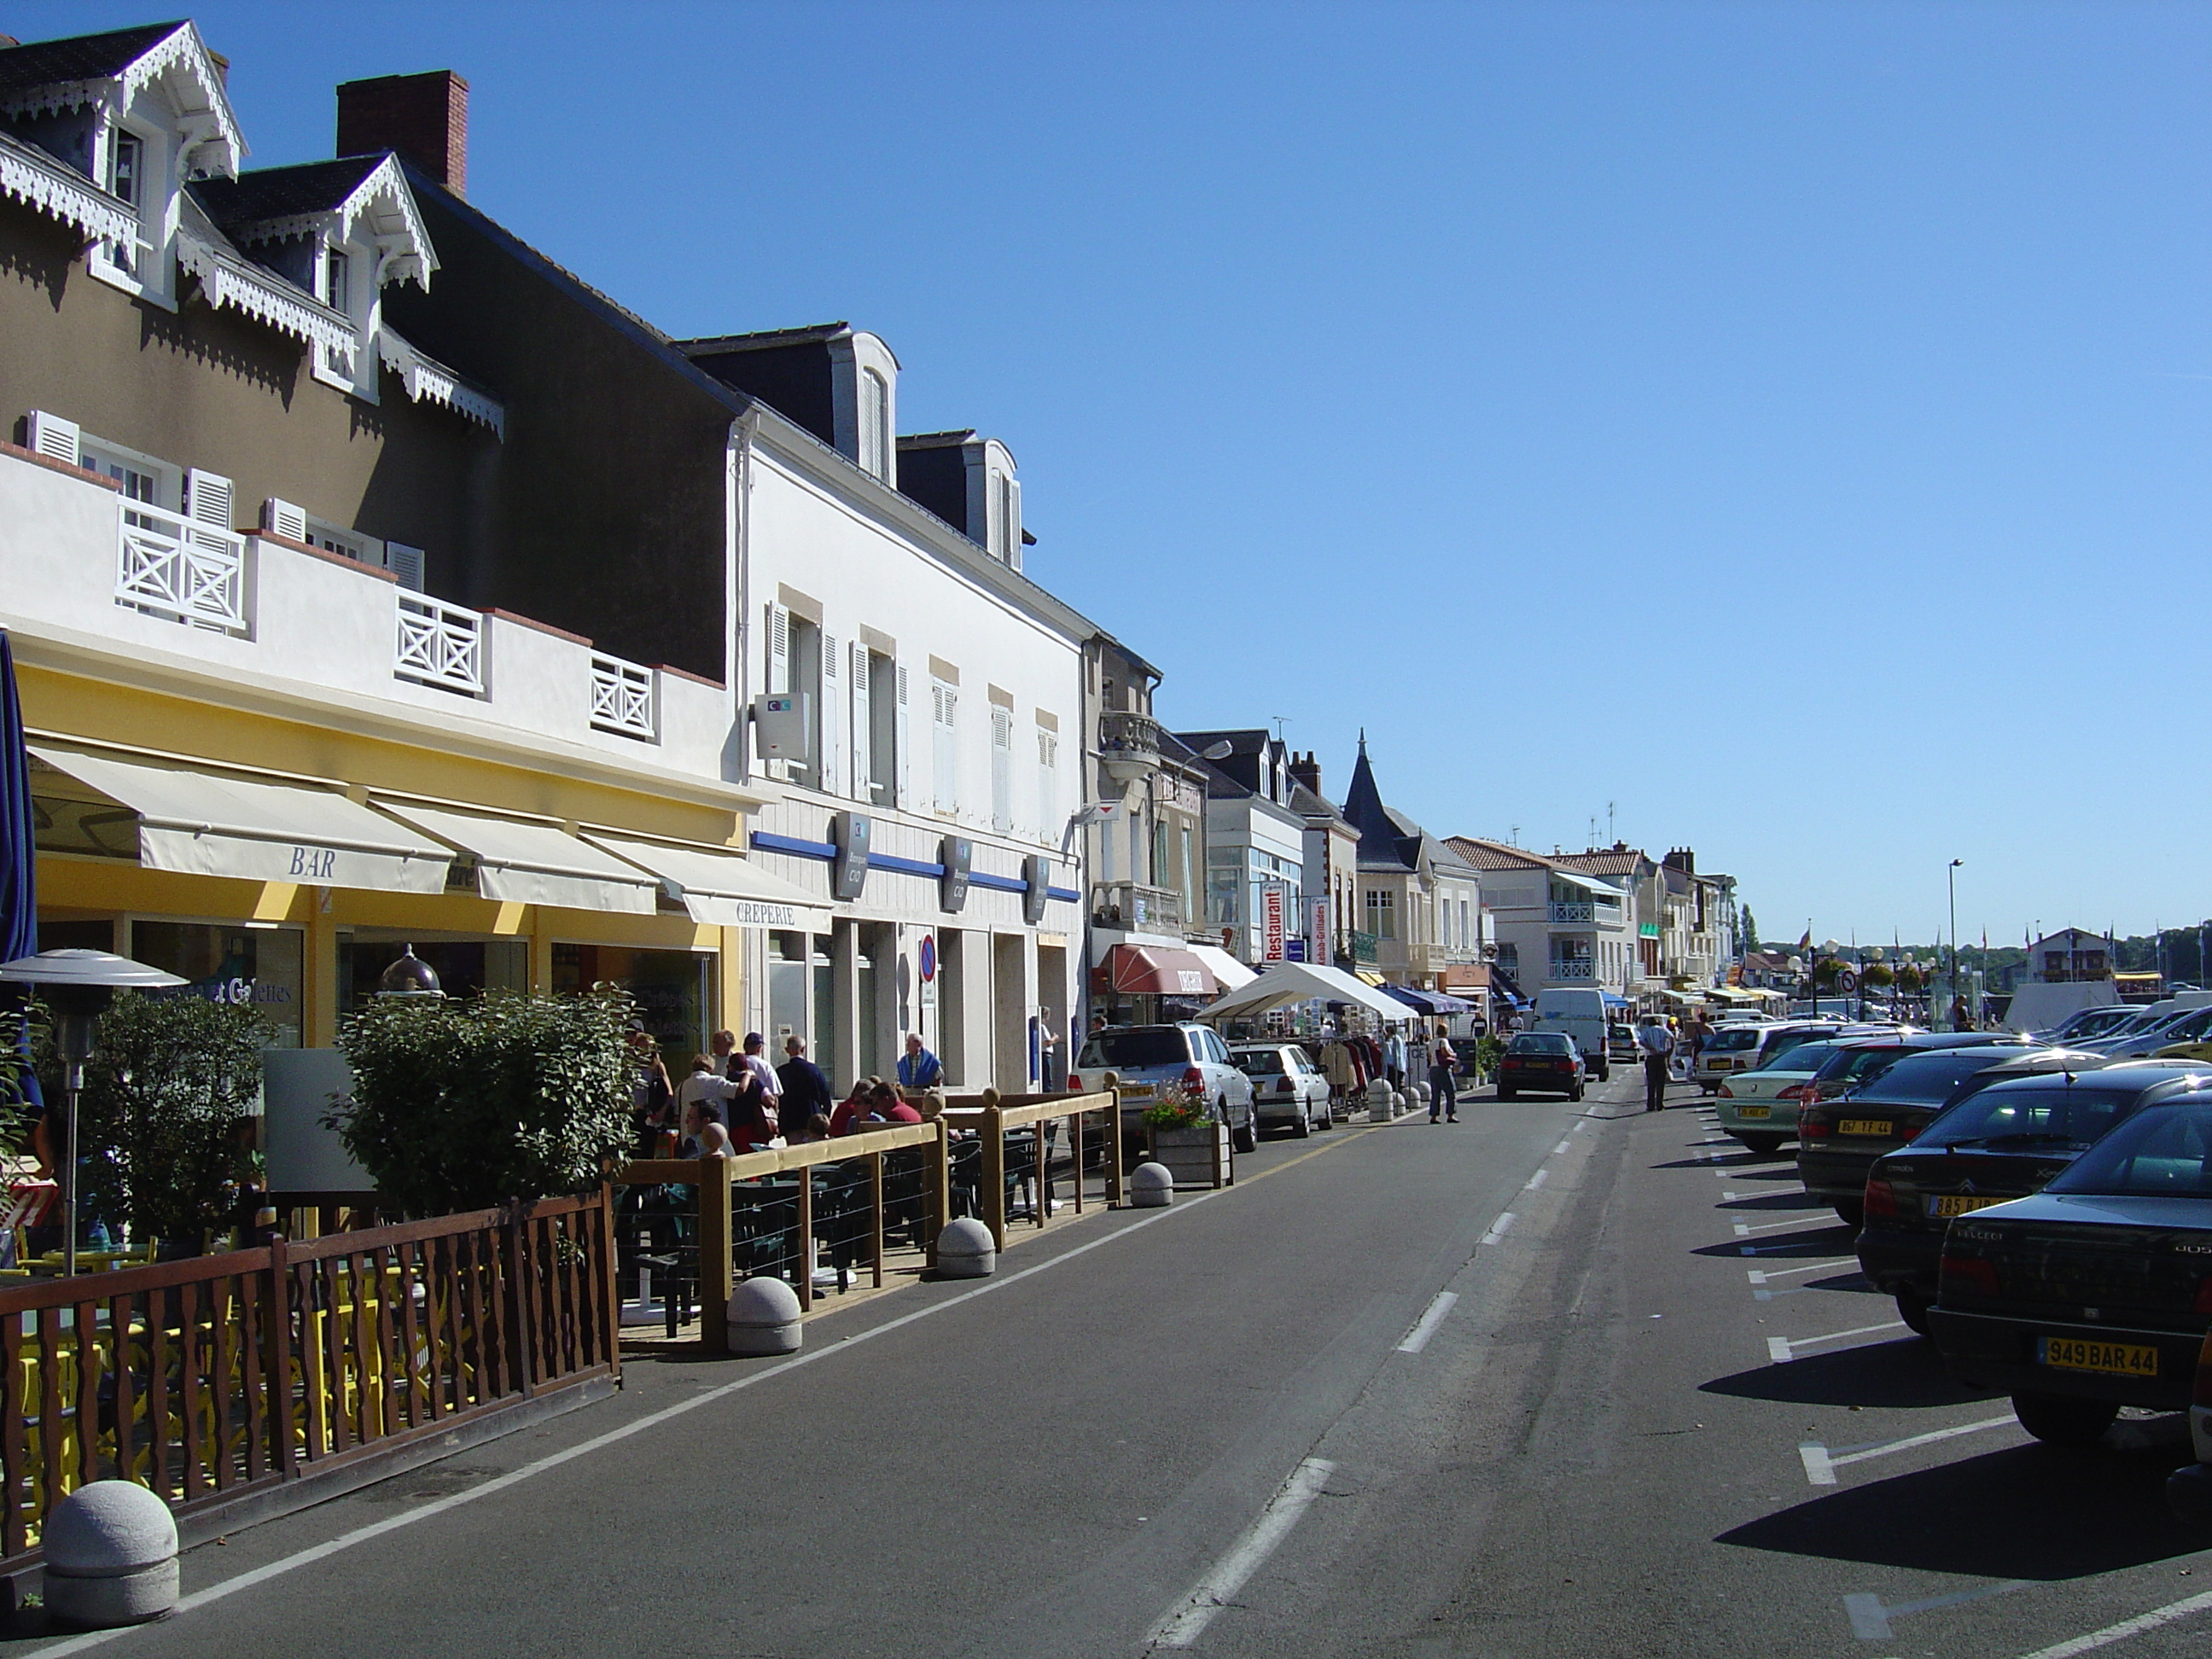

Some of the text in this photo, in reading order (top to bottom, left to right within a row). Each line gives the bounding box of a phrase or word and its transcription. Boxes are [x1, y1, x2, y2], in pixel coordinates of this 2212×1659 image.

[288, 847, 336, 878] BAR
[736, 902, 795, 926] CREPERIE
[1265, 892, 1283, 961] Restaurant
[1936, 1198, 1960, 1214] 885
[2051, 1341, 2154, 1371] 949 BAR 44
